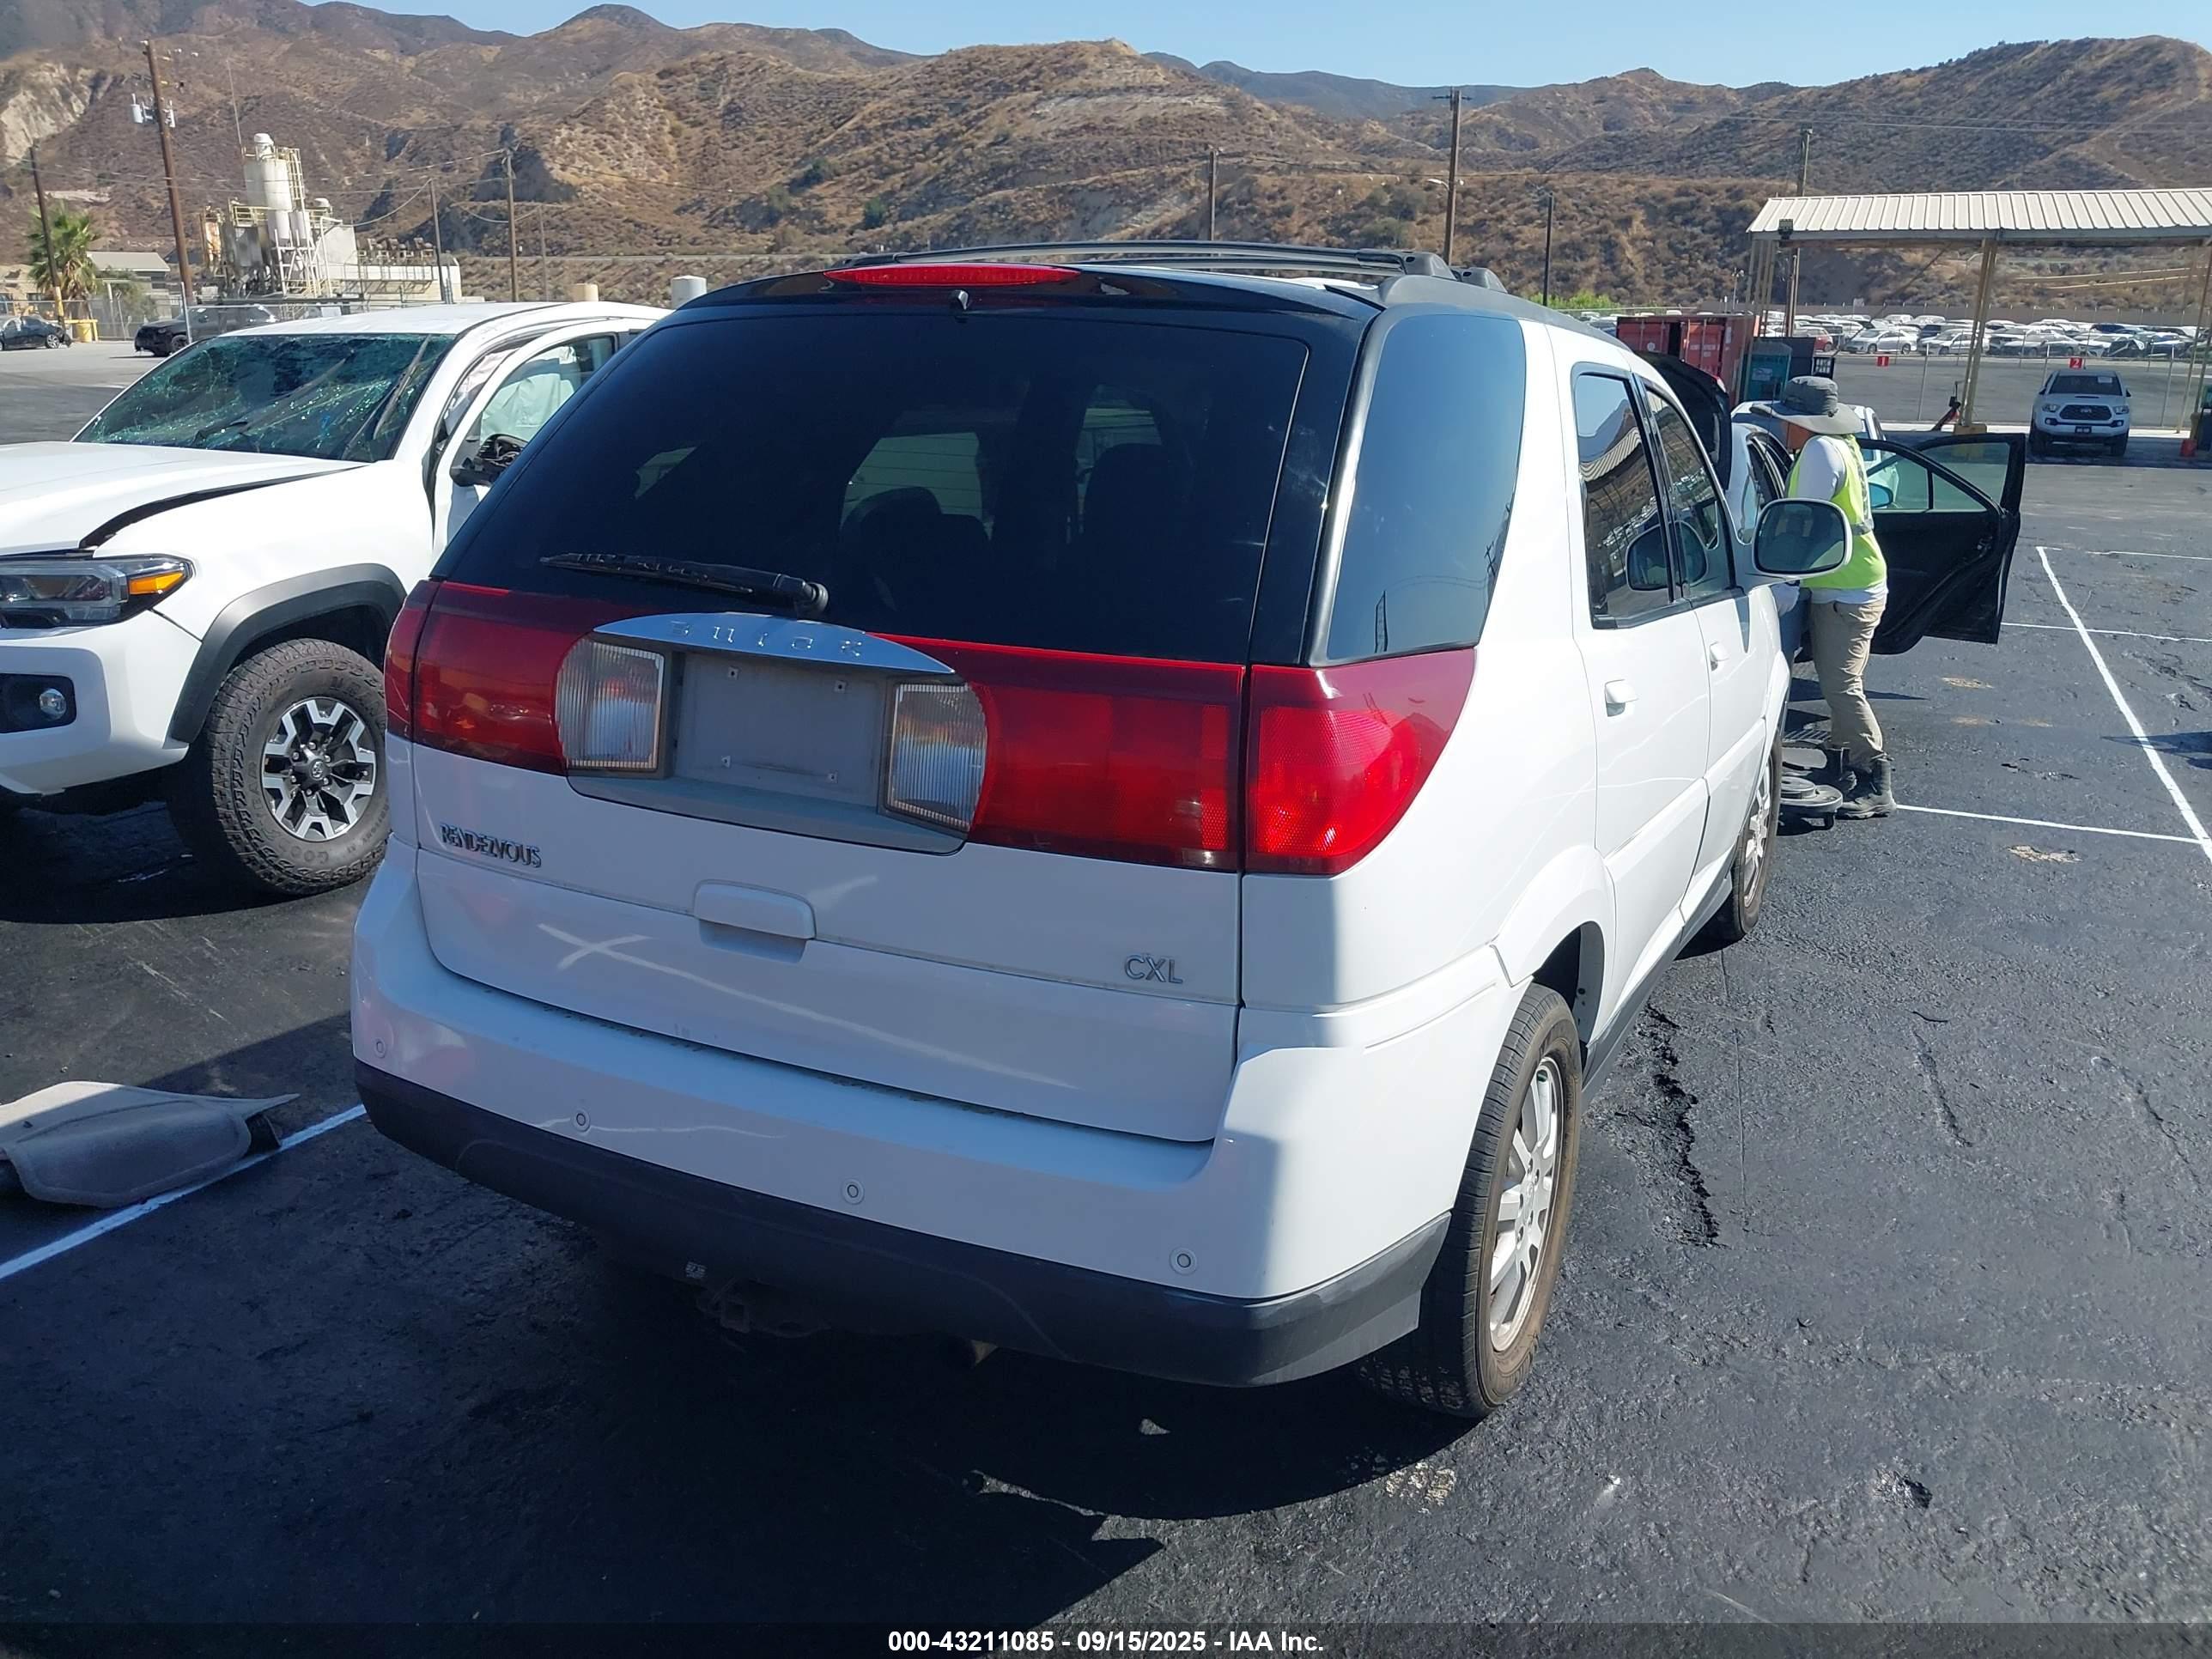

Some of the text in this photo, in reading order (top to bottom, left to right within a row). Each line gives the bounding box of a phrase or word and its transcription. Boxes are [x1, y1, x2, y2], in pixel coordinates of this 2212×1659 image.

[2072, 358, 2080, 368] 2
[672, 620, 863, 659] BUICK
[440, 823, 542, 868] RENDEZVOUS
[1124, 953, 1183, 984] CXL
